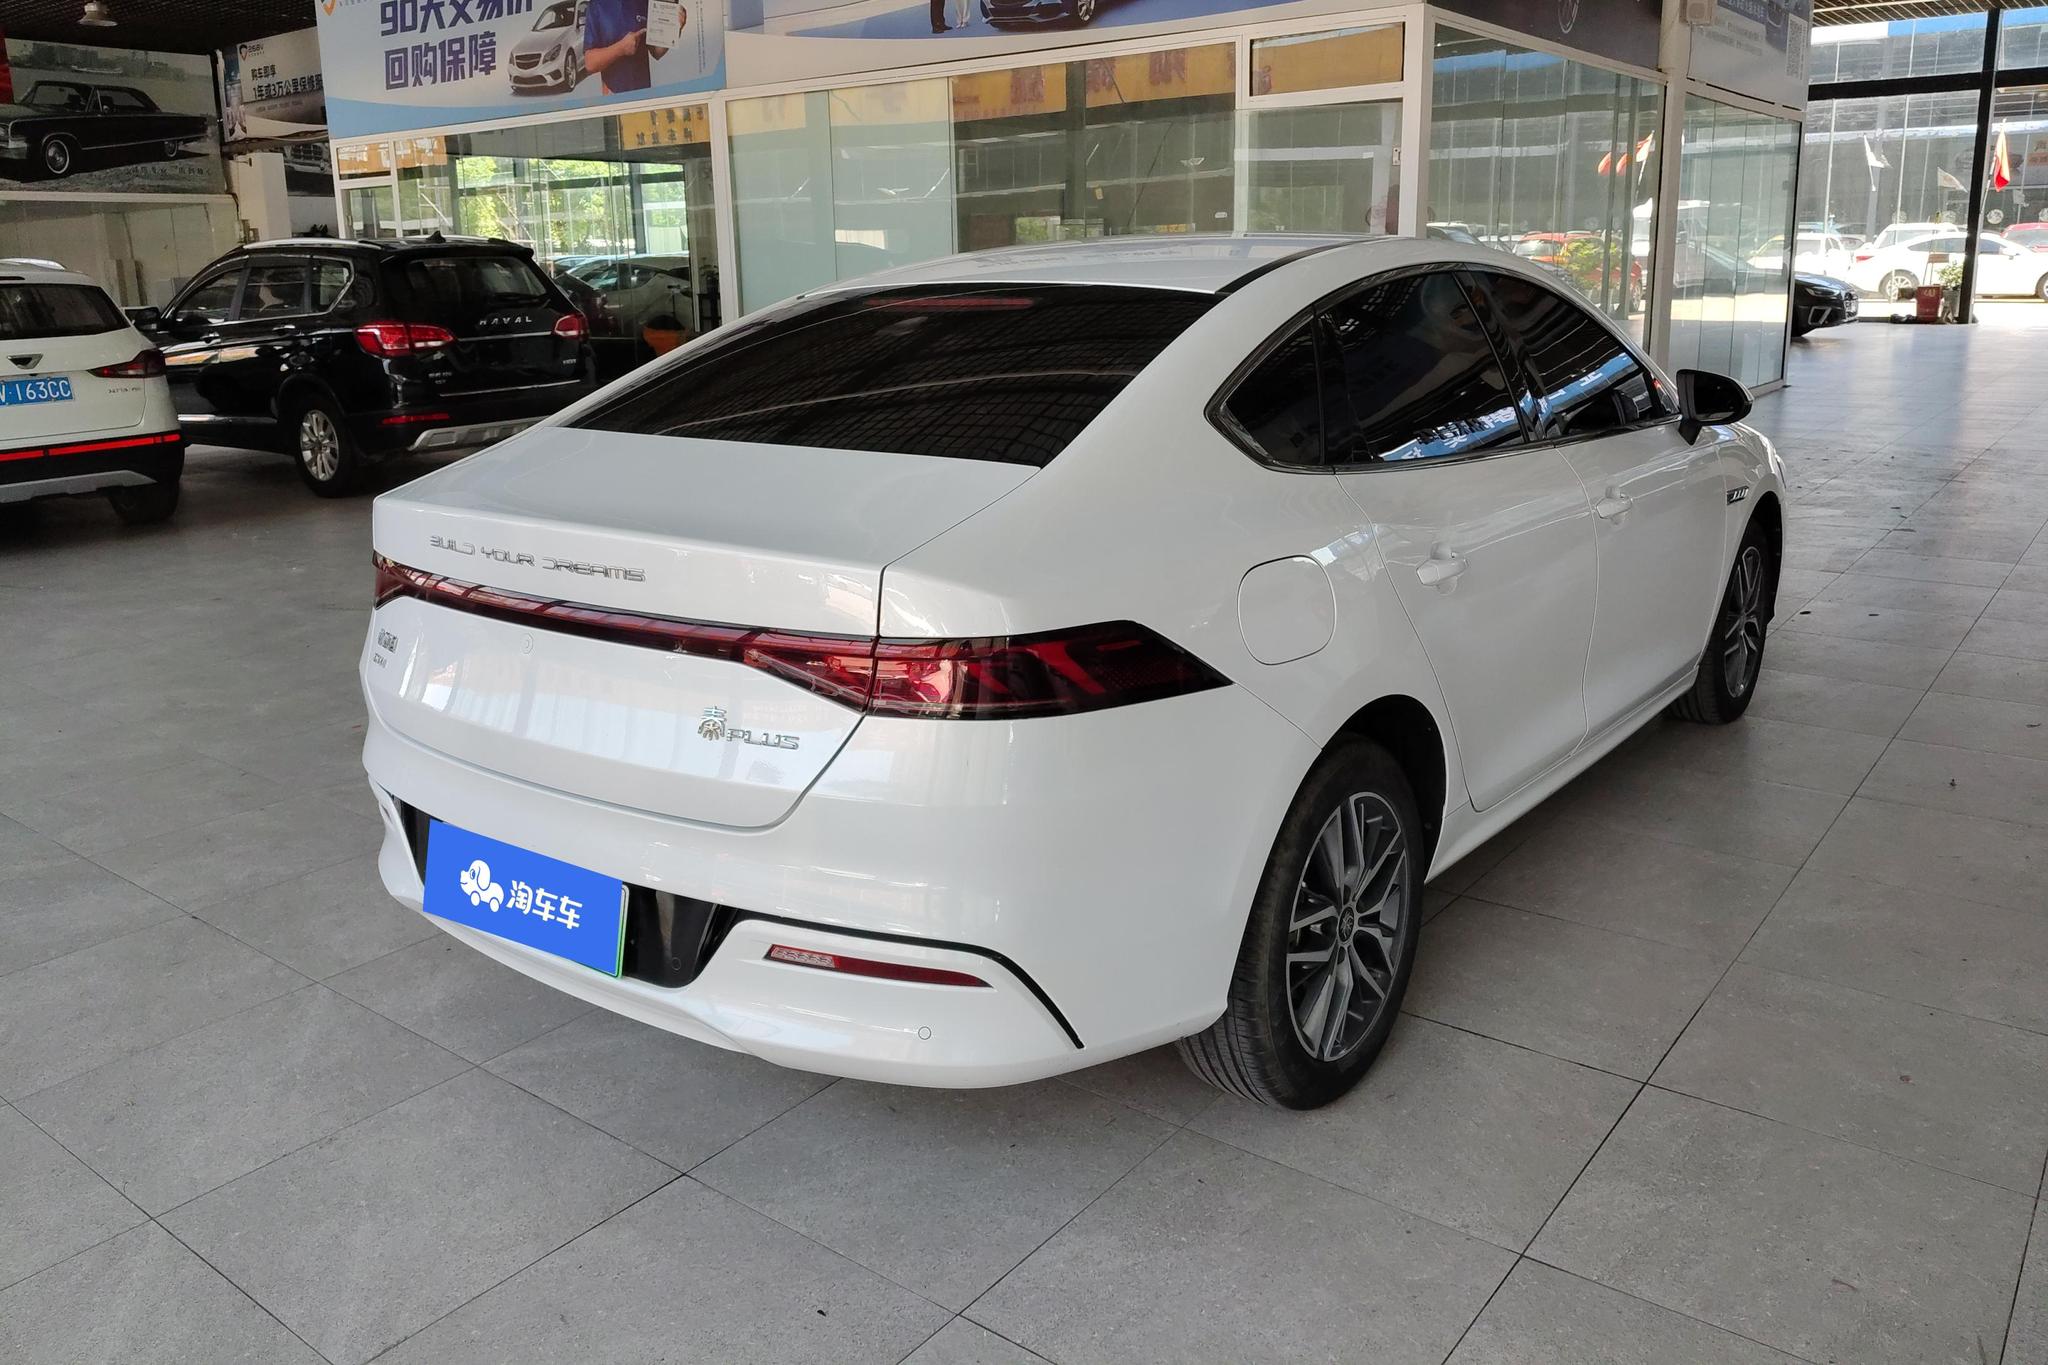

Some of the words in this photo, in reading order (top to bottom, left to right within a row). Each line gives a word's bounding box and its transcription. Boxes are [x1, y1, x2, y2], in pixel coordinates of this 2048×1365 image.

[385, 31, 496, 90] 回购保障
[479, 316, 532, 325] HAVAL
[430, 535, 474, 556] BUILD
[481, 545, 535, 567] YOUR
[542, 556, 645, 582] DREAMS
